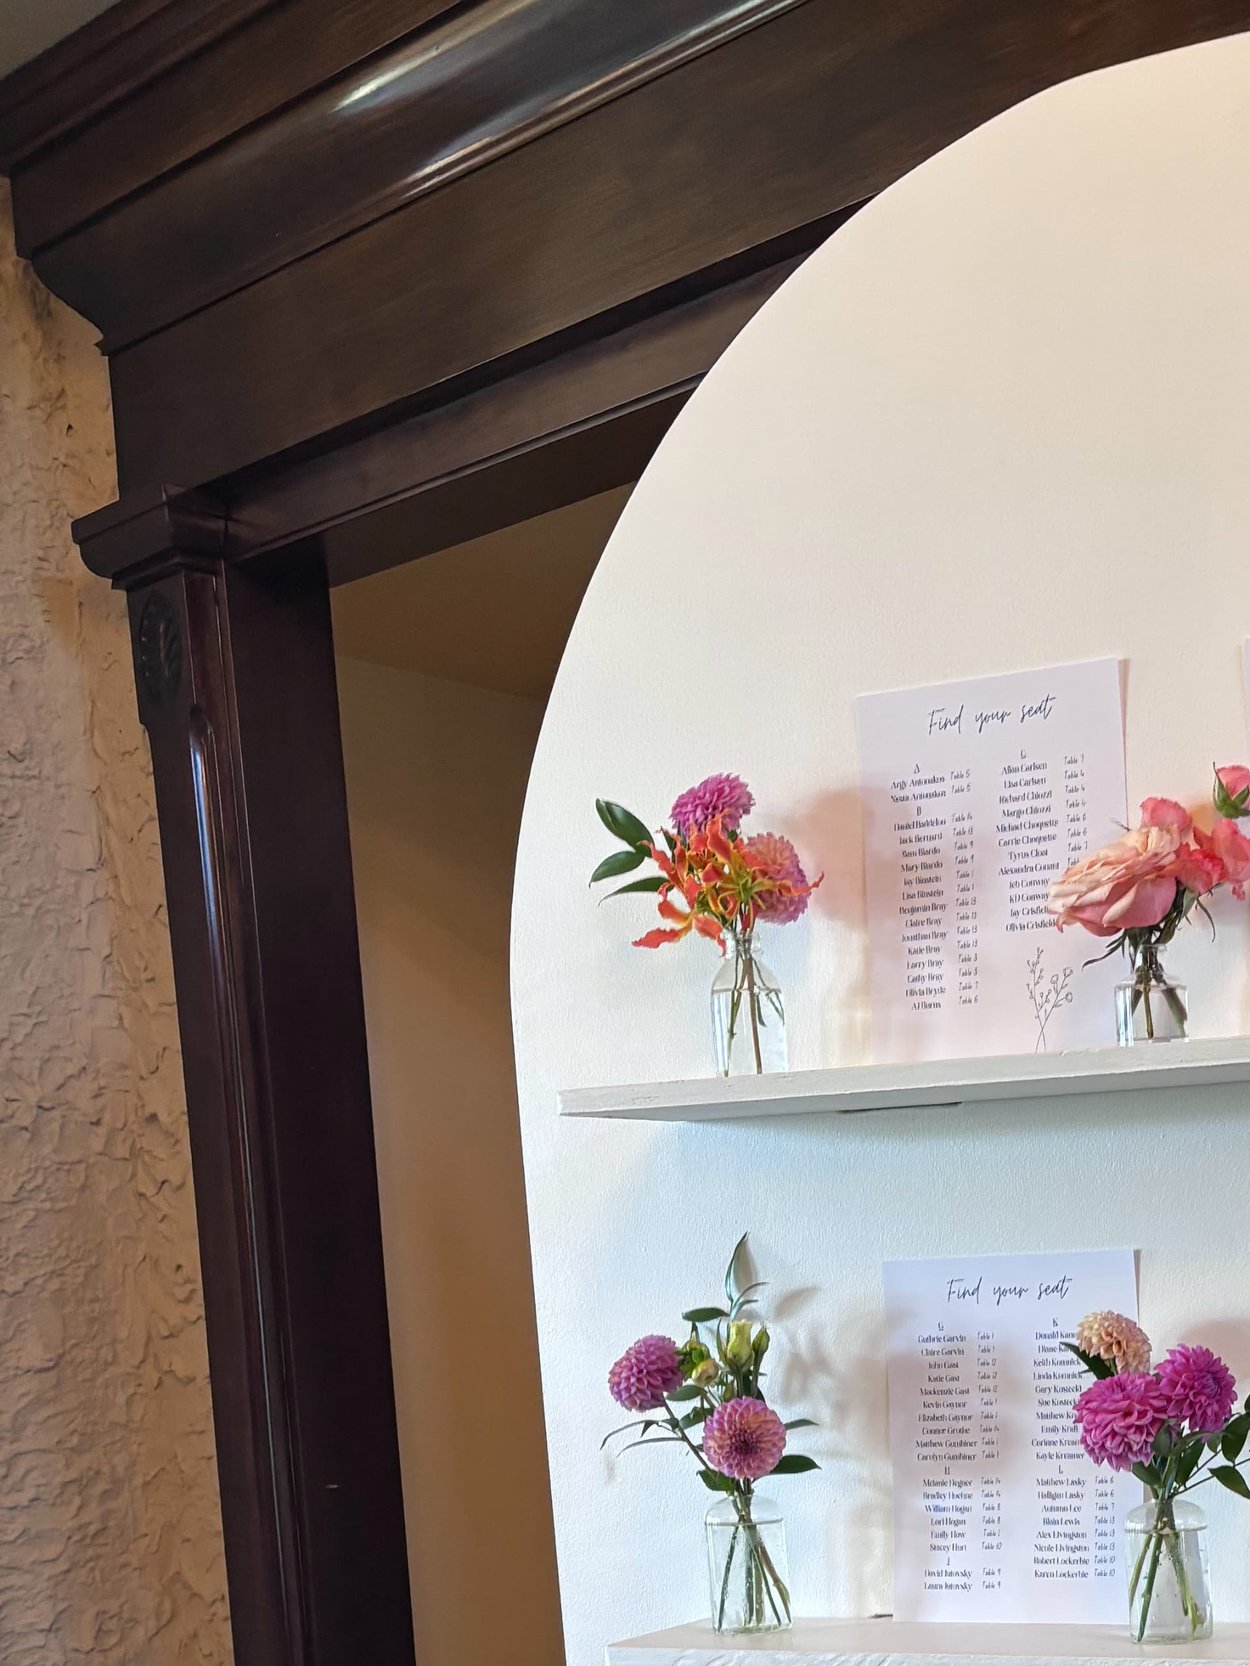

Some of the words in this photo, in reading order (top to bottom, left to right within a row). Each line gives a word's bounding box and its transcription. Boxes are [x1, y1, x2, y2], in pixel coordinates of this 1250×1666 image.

[927, 704, 964, 736] Find
[974, 708, 1011, 734] your
[1020, 693, 1057, 725] seat
[1004, 779, 1018, 789] Lisa
[1064, 770, 1079, 780] Table
[999, 837, 1021, 848] Carrie
[1067, 828, 1081, 838] Table
[901, 863, 919, 873] Mary
[955, 855, 968, 865] Table
[905, 918, 925, 928] Claire
[926, 917, 943, 927] Bray
[956, 912, 970, 922] Table
[946, 1276, 983, 1304] Find
[991, 1285, 1029, 1306] your
[1038, 1275, 1074, 1300] seat
[941, 1348, 965, 1357] Garvin
[978, 1344, 991, 1353] Table
[978, 1384, 991, 1393] Table
[1036, 1477, 1065, 1486] Matthew
[1095, 1475, 1108, 1484] Table
